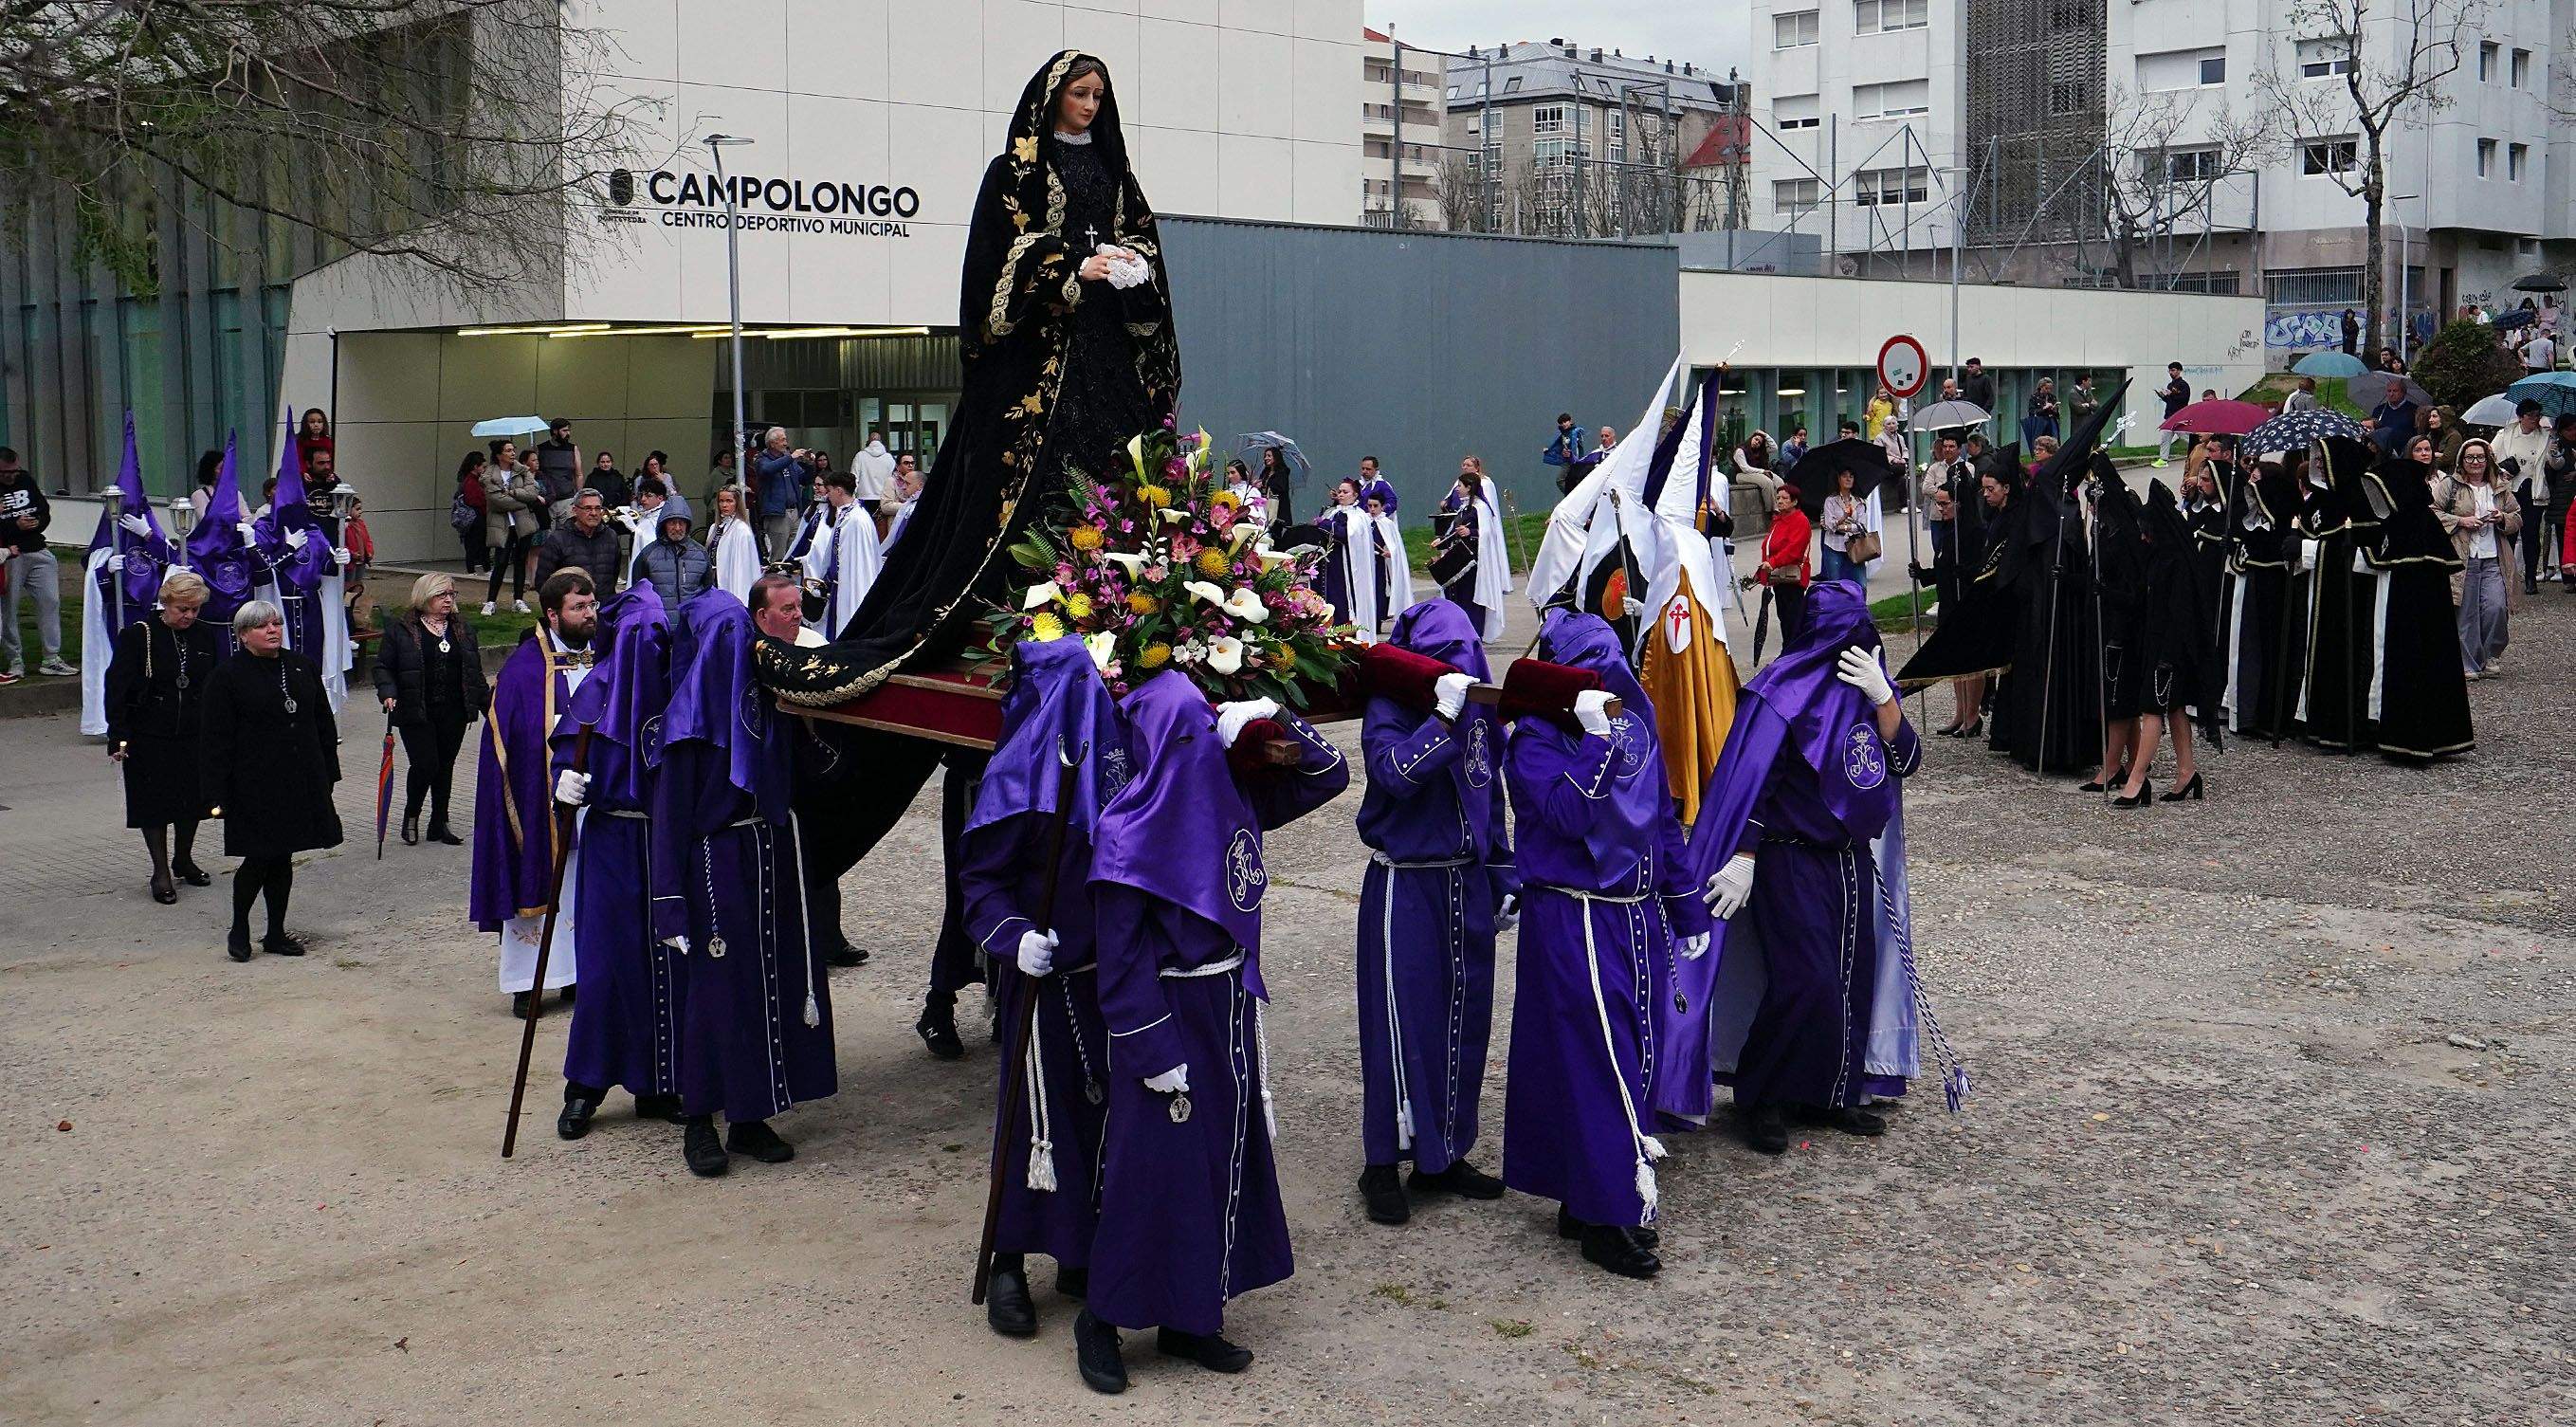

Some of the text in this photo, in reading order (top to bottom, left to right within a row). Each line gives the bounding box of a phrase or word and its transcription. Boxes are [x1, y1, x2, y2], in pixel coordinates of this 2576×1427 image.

[649, 171, 920, 218] CAMPOLONGO
[662, 211, 909, 237] CENTRO DEPORTIVO MUNICIPAL
